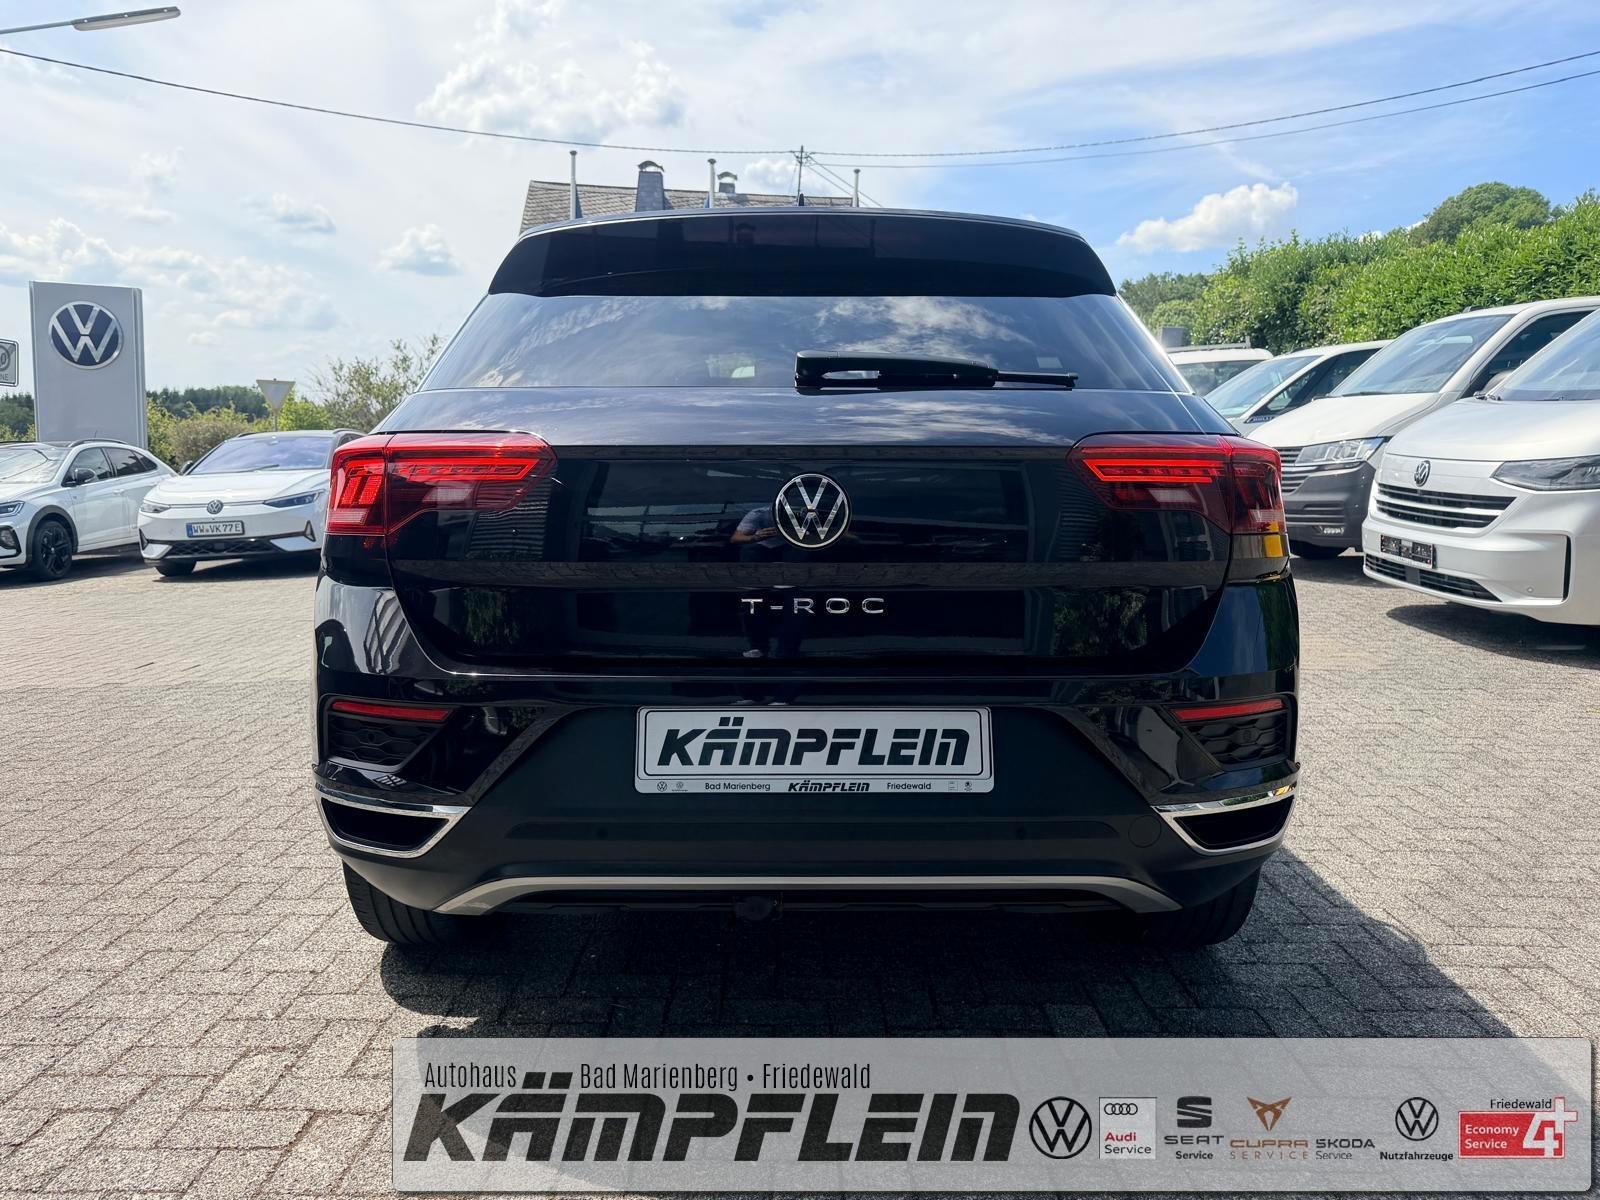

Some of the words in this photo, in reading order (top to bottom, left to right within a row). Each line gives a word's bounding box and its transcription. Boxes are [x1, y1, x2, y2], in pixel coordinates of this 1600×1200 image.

[741, 598, 885, 614] T-ROC
[657, 716, 970, 766] KÄMPFLEIN
[704, 782, 721, 790] Bad
[723, 782, 771, 791] Marienberg
[788, 780, 870, 792] KÄMPFLEIN
[886, 782, 932, 790] Friedewald
